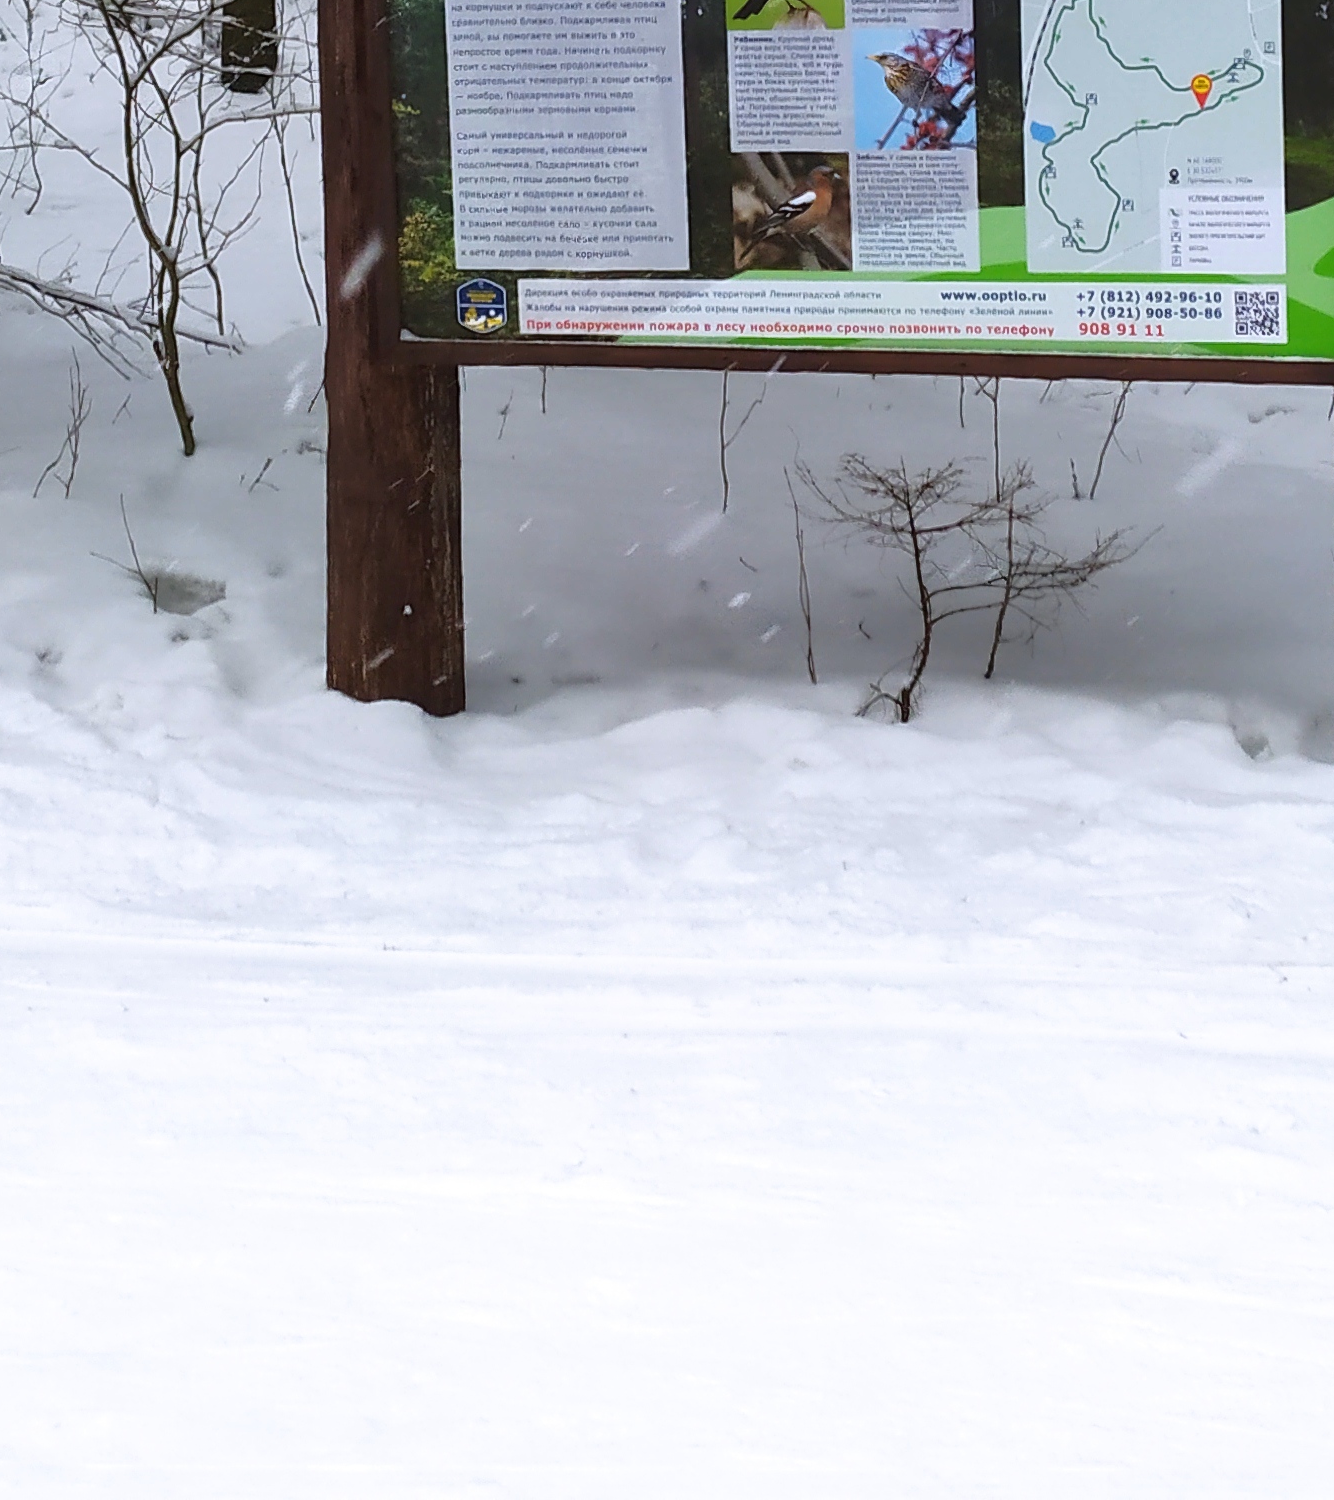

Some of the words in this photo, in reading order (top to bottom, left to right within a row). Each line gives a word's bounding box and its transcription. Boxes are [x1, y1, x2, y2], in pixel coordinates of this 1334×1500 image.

[940, 291, 1046, 301] www.ooptlo.ru
[1076, 290, 1094, 301] +7
[1100, 290, 1140, 304] (812)
[1144, 290, 1221, 303] 492-96-10
[1076, 305, 1095, 317] +7
[1100, 306, 1140, 320] (921)
[1145, 307, 1222, 319] 908-50-86
[527, 319, 551, 331] При
[555, 320, 644, 334] обнаружении
[649, 322, 699, 331] пожара
[703, 323, 711, 331] в
[715, 323, 745, 333] лесу
[749, 323, 832, 333] необходимо
[836, 324, 884, 334] срочно
[889, 324, 961, 333] позвонить
[965, 325, 982, 334] по
[986, 325, 1054, 336] телефону
[1078, 322, 1110, 335] 908
[1116, 322, 1137, 336] 91
[1144, 324, 1164, 336] 11
